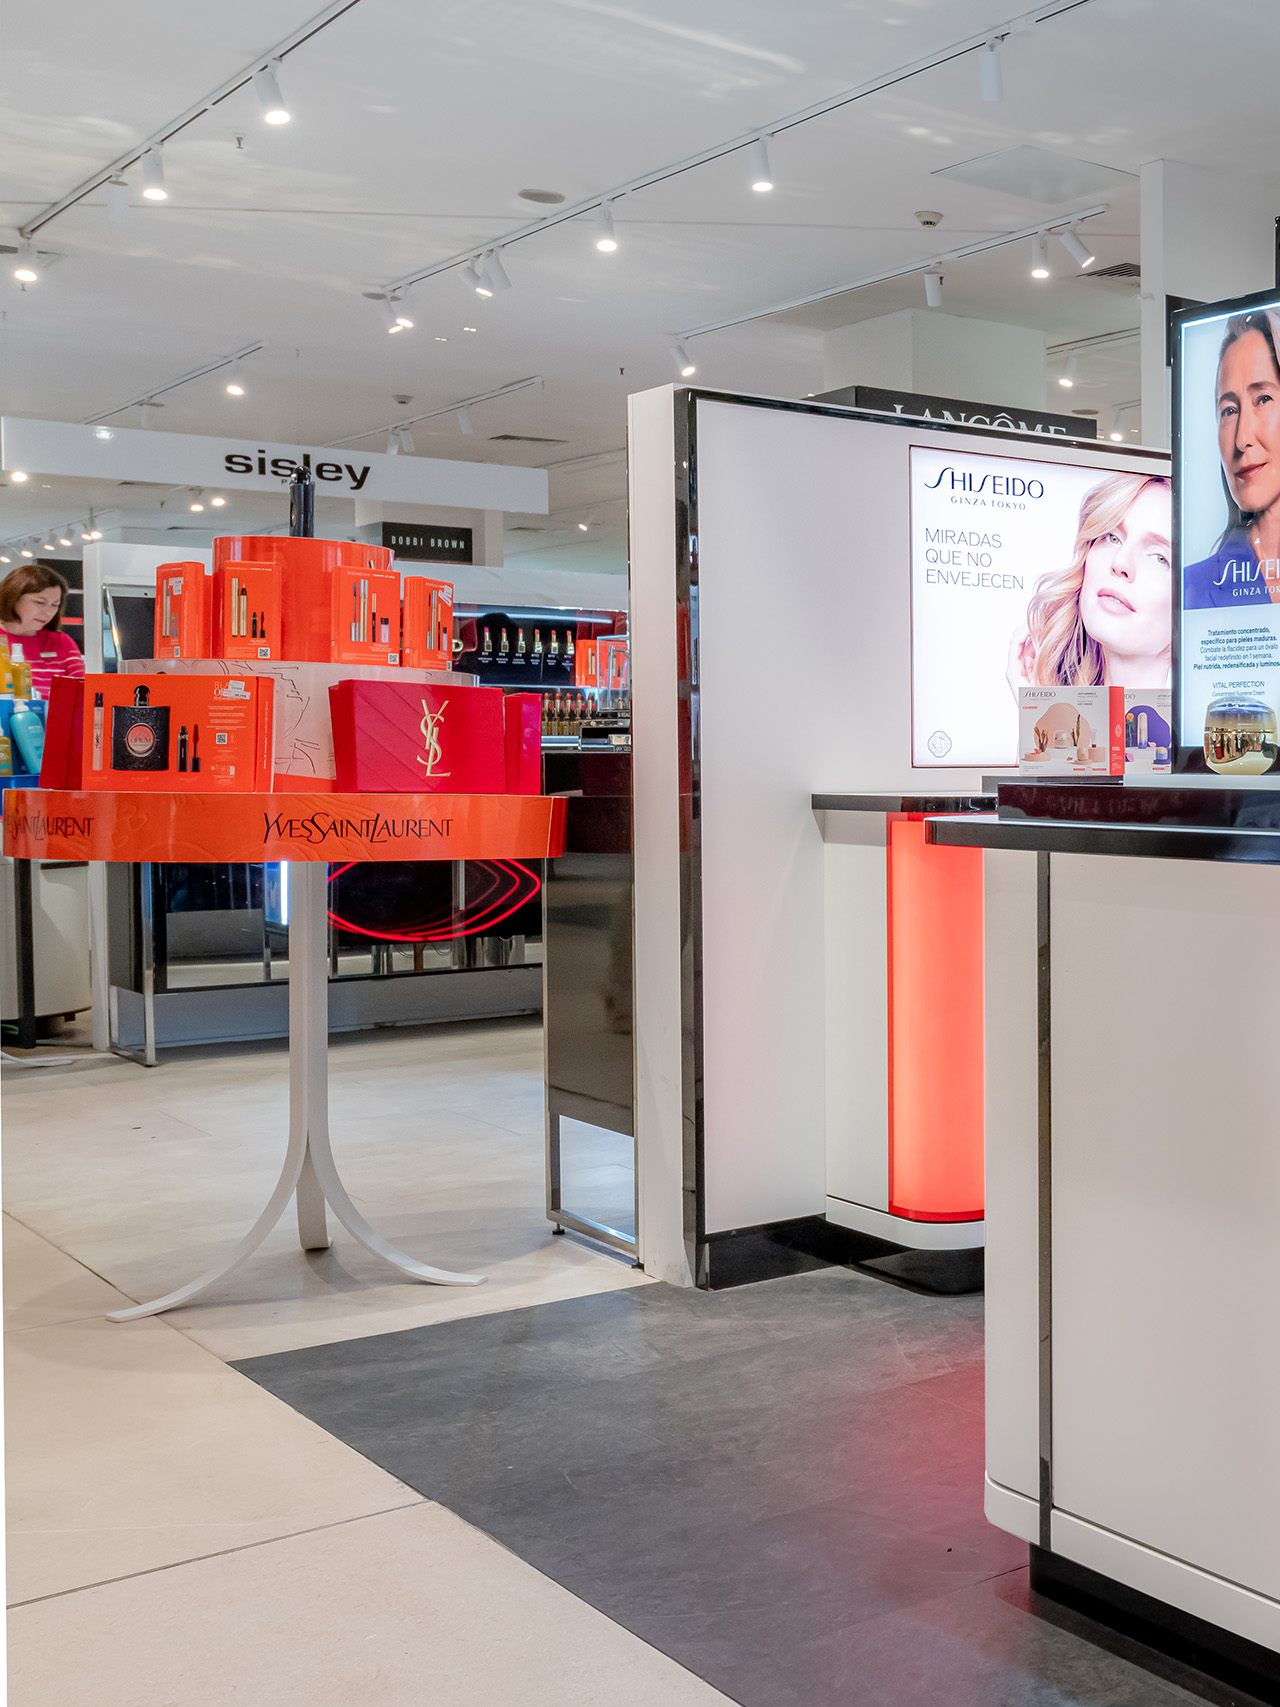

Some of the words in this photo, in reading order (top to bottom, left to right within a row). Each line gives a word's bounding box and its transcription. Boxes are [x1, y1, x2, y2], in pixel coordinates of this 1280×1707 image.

[224, 449, 371, 490] sisley
[924, 466, 1044, 499] SHISEIDO
[950, 495, 987, 507] GINZA
[991, 499, 1026, 511] TOKYO
[391, 535, 423, 546] BOBBI
[430, 538, 465, 549] BROWN
[925, 527, 1003, 549] MIRADAS
[925, 548, 963, 565] QUE
[967, 551, 992, 568] NO
[926, 568, 1024, 590] ENVEJECEN
[1232, 587, 1261, 597] GINZA
[1237, 626, 1271, 635] concentrado,
[1226, 637, 1237, 645] para
[1238, 636, 1253, 644] pieles
[1254, 634, 1277, 642] maduras.
[1200, 646, 1221, 654] Combate
[1246, 645, 1257, 653] para
[1218, 653, 1242, 661] redefinido
[1203, 662, 1222, 670] nutrida,
[1222, 661, 1256, 669] redensificada
[1229, 680, 1265, 688] PERFECTION
[1023, 690, 1056, 698] SHISEIDO
